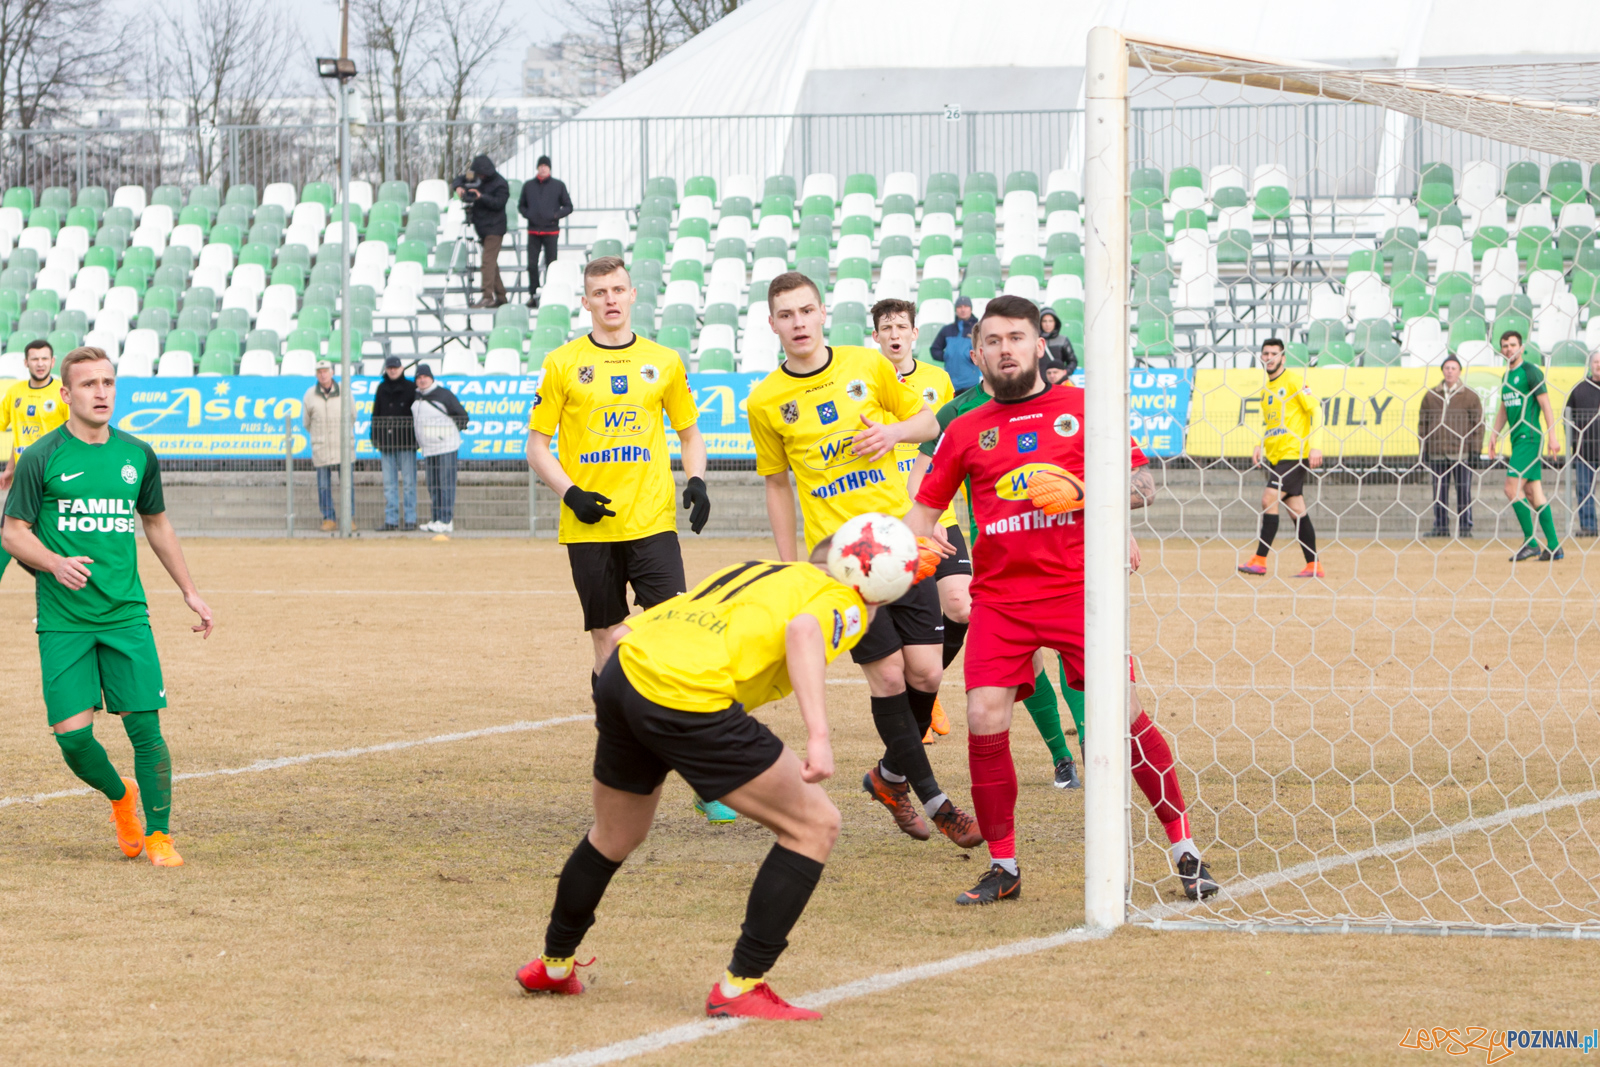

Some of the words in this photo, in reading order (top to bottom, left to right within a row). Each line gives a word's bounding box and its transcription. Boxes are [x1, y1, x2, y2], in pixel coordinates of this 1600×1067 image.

[946, 109, 960, 119] 26
[131, 391, 168, 403] GRUPA
[117, 387, 303, 432] Astra
[604, 411, 636, 428] WP
[1238, 395, 1394, 426] FMILY
[811, 468, 886, 499] NORTHPOL
[57, 499, 135, 514] FAMILY
[57, 516, 135, 532] HOUSE
[985, 507, 1076, 536] NORTHPOL
[690, 560, 794, 604] 11
